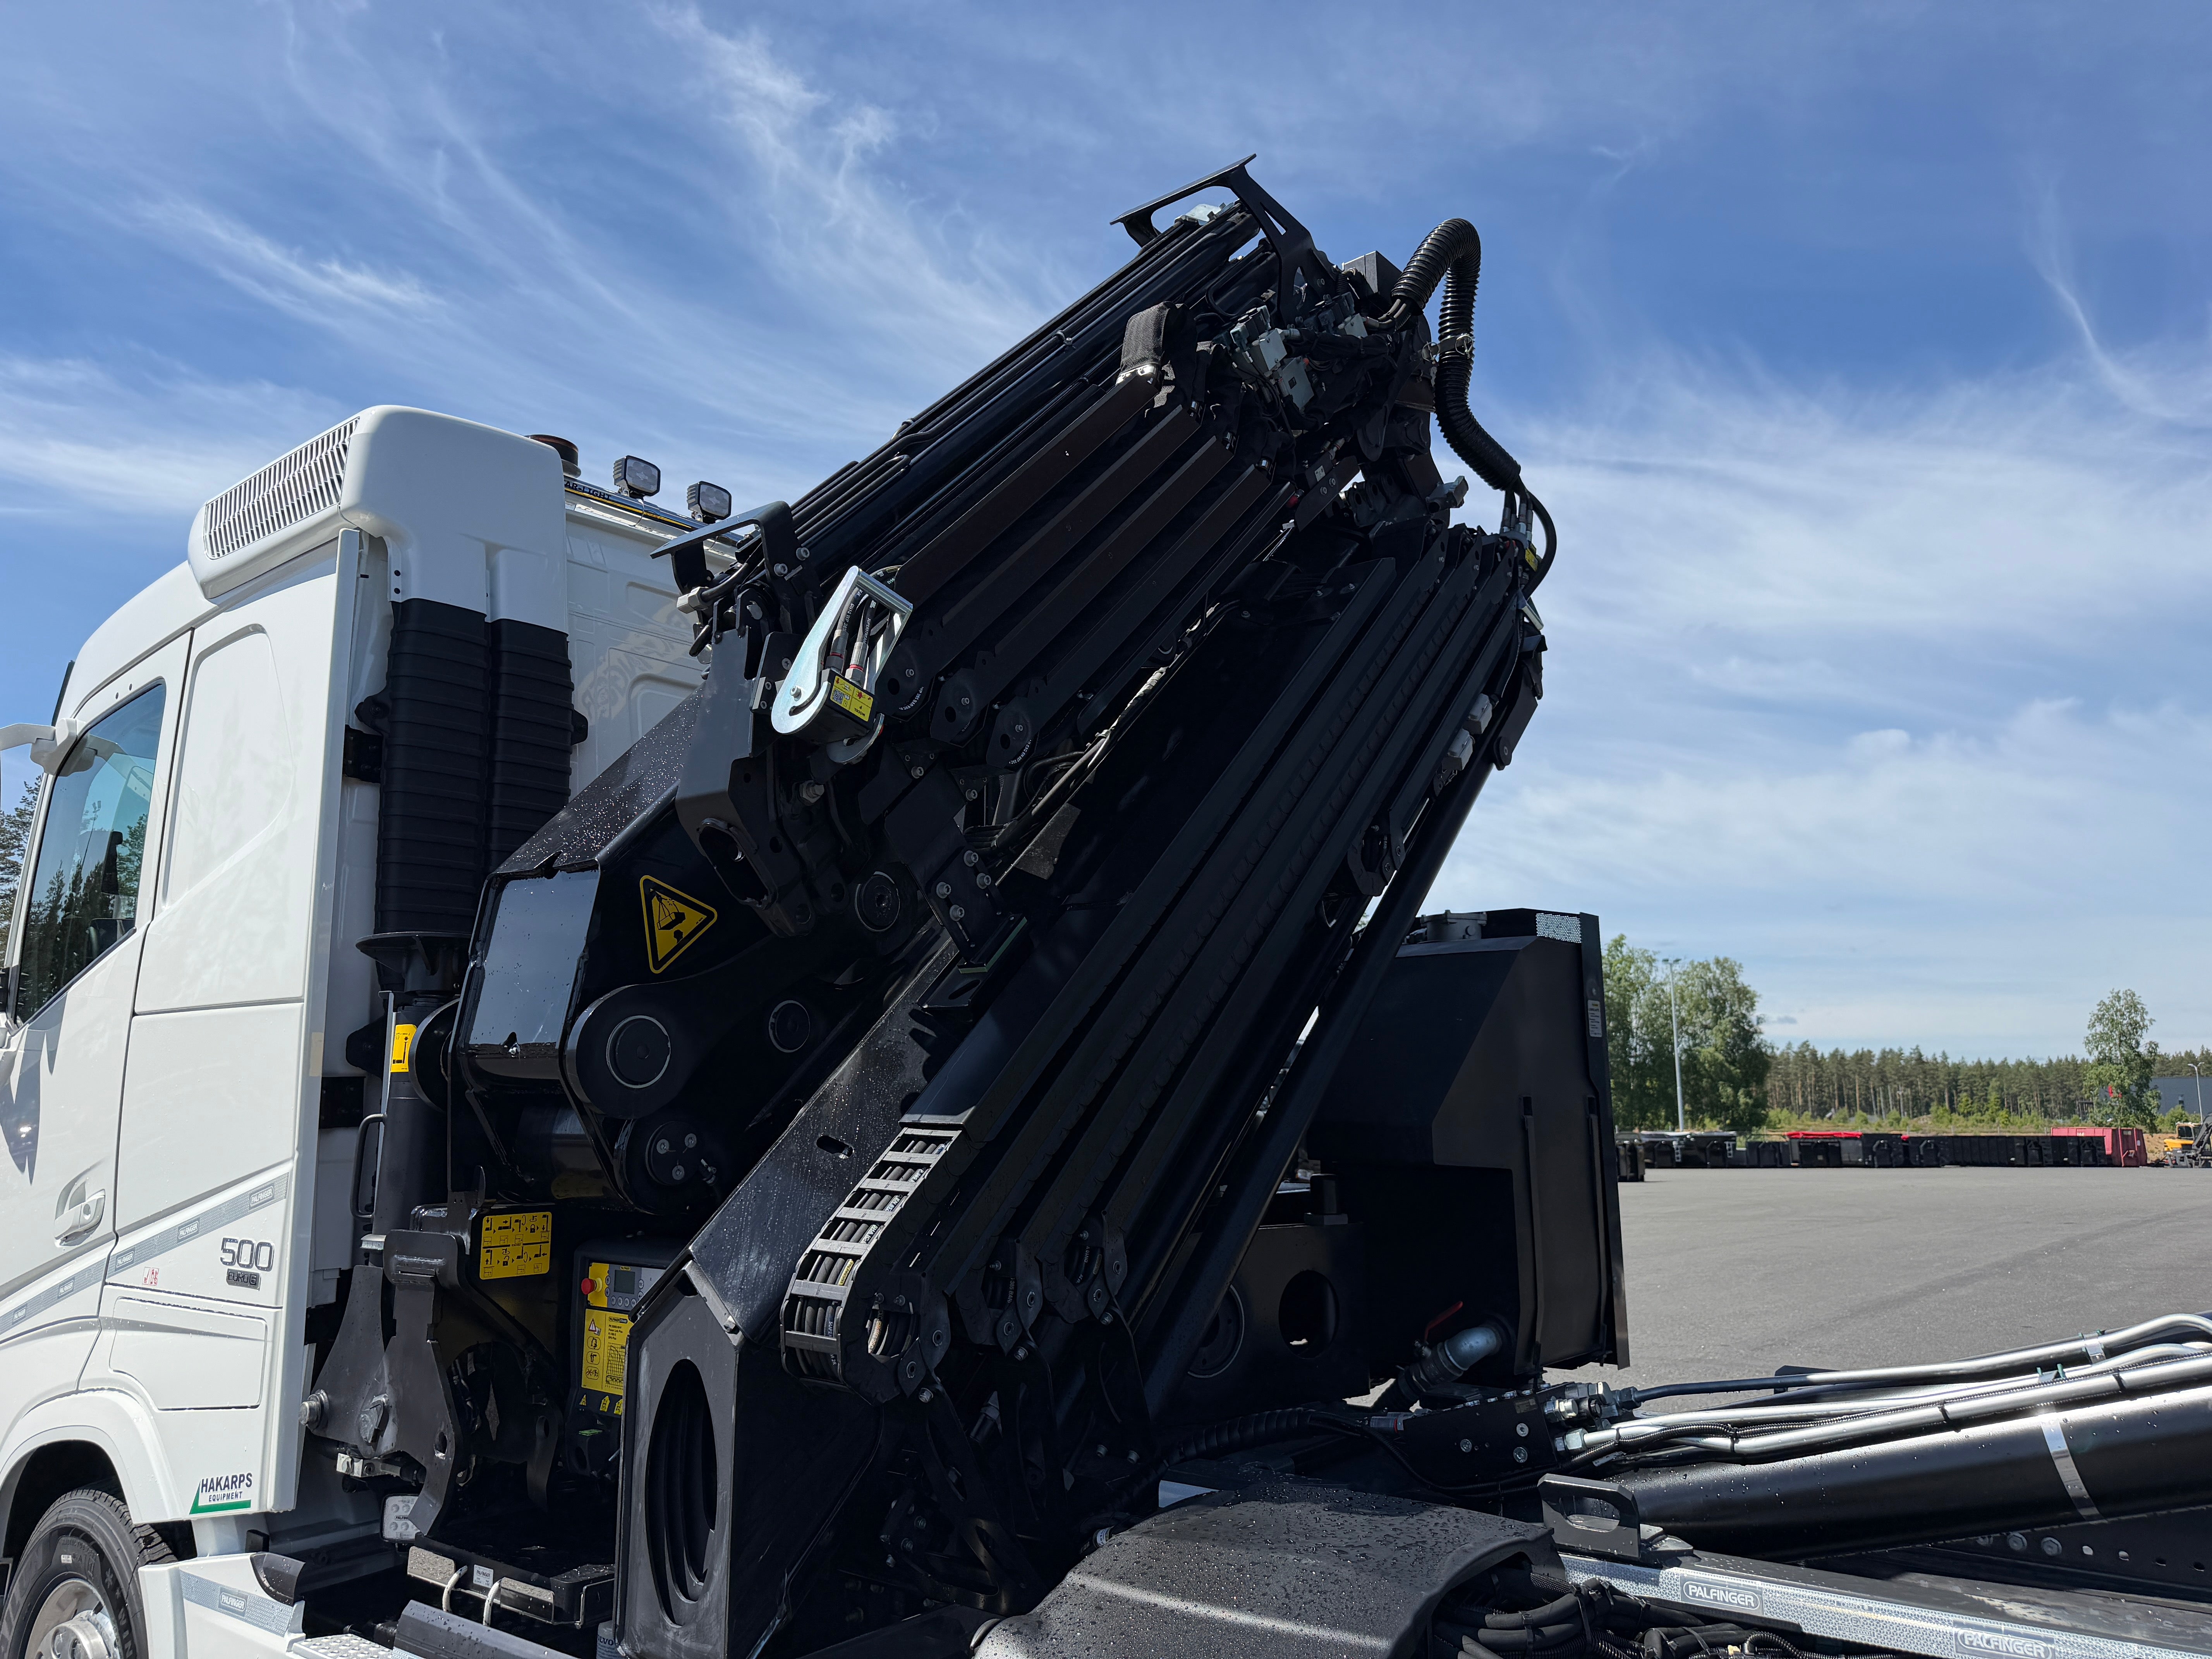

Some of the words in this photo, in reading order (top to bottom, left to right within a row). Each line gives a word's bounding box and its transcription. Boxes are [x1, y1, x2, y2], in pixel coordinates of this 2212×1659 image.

[564, 480, 611, 499] AR-LIGHT
[251, 1187, 273, 1205] PALFINGER
[179, 1224, 198, 1237] PALFINGER
[220, 1237, 274, 1272] 500
[201, 1472, 252, 1493] HAKARPS
[209, 1491, 242, 1502] EQUIPMENT
[221, 1594, 244, 1609] PALFINGER
[1688, 1585, 1755, 1607] PALFINGER
[1964, 1631, 2045, 1659] PALFINGER
